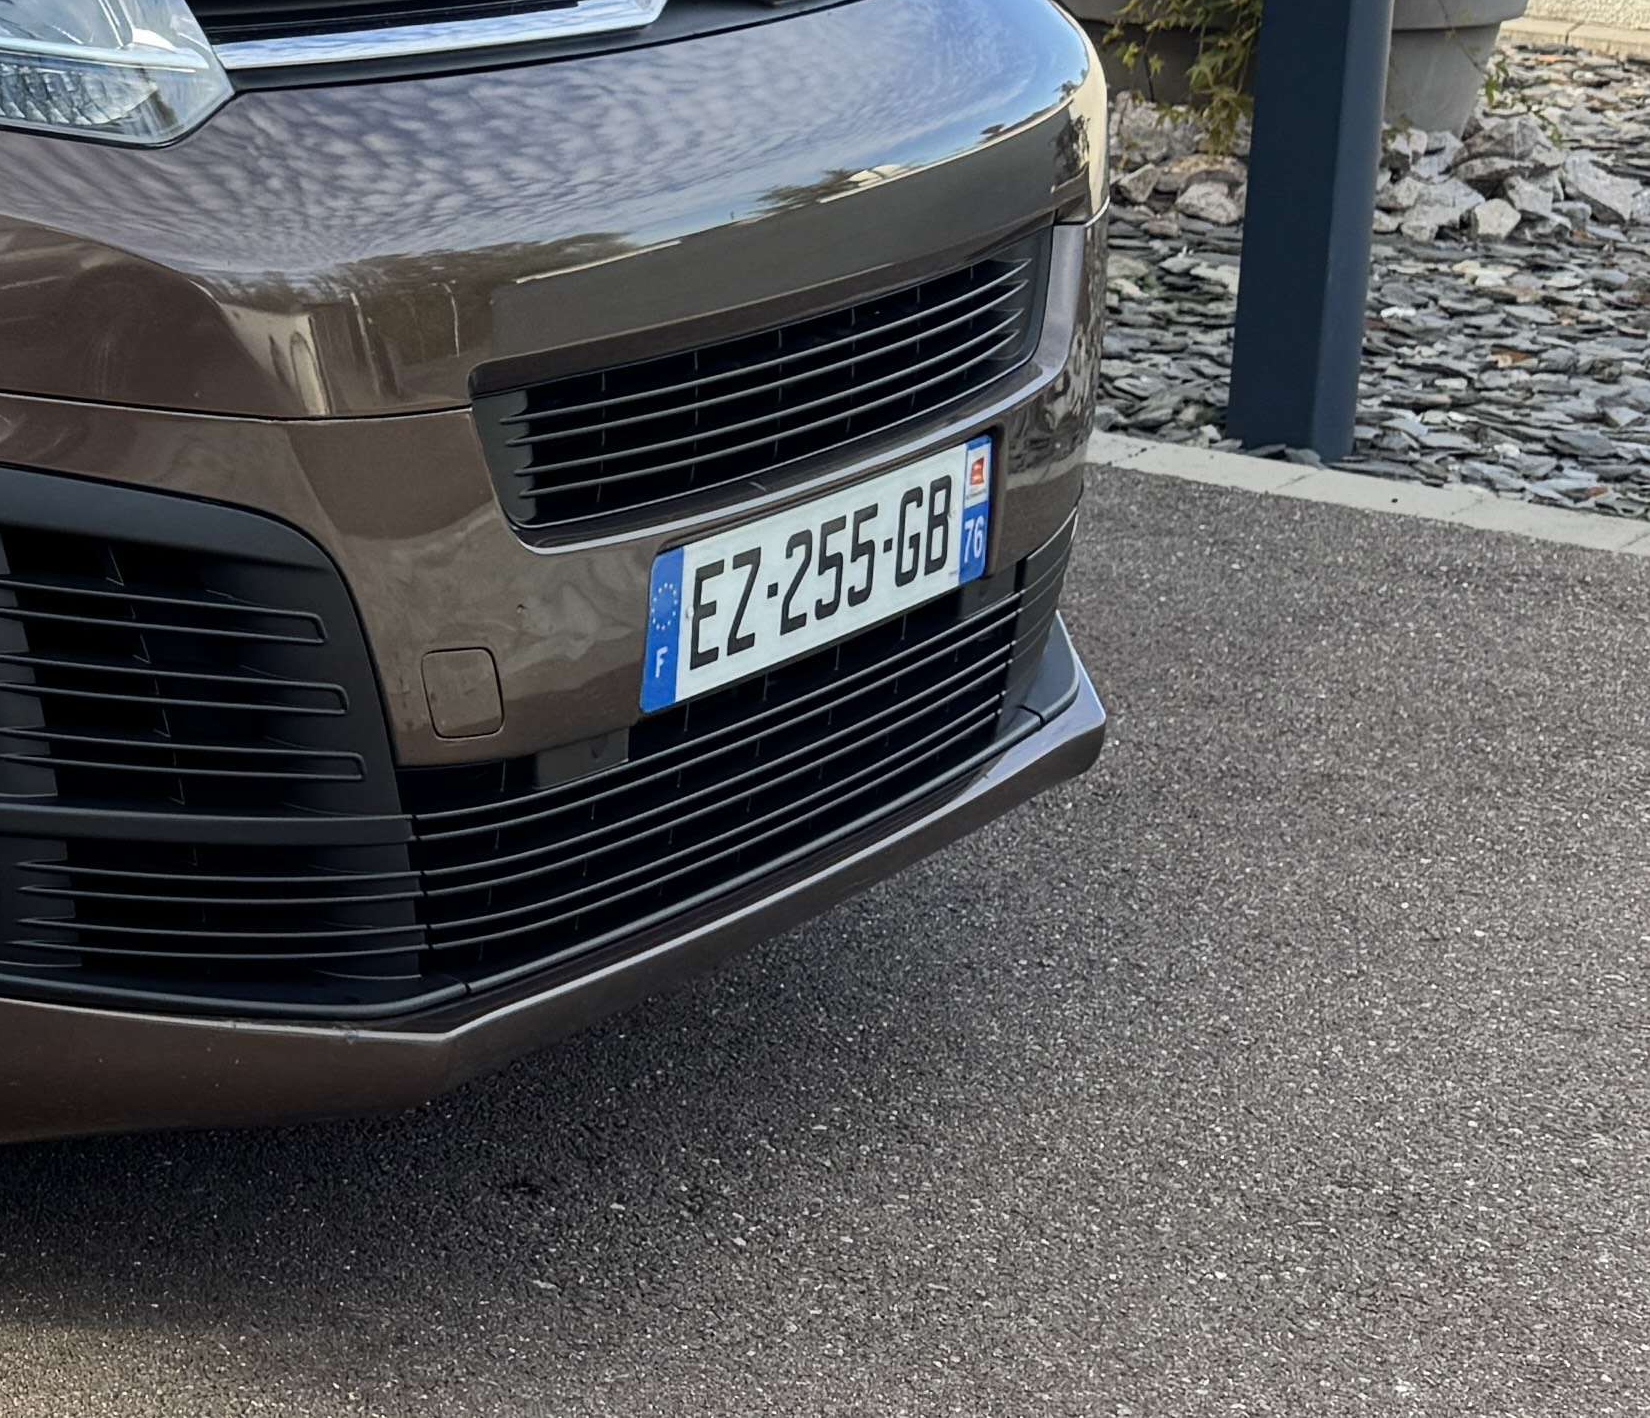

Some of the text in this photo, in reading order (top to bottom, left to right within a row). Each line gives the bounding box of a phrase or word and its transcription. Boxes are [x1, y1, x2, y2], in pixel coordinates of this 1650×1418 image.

[964, 516, 984, 563] 76
[689, 475, 952, 670] EZ-255-GB
[653, 646, 668, 679] F
